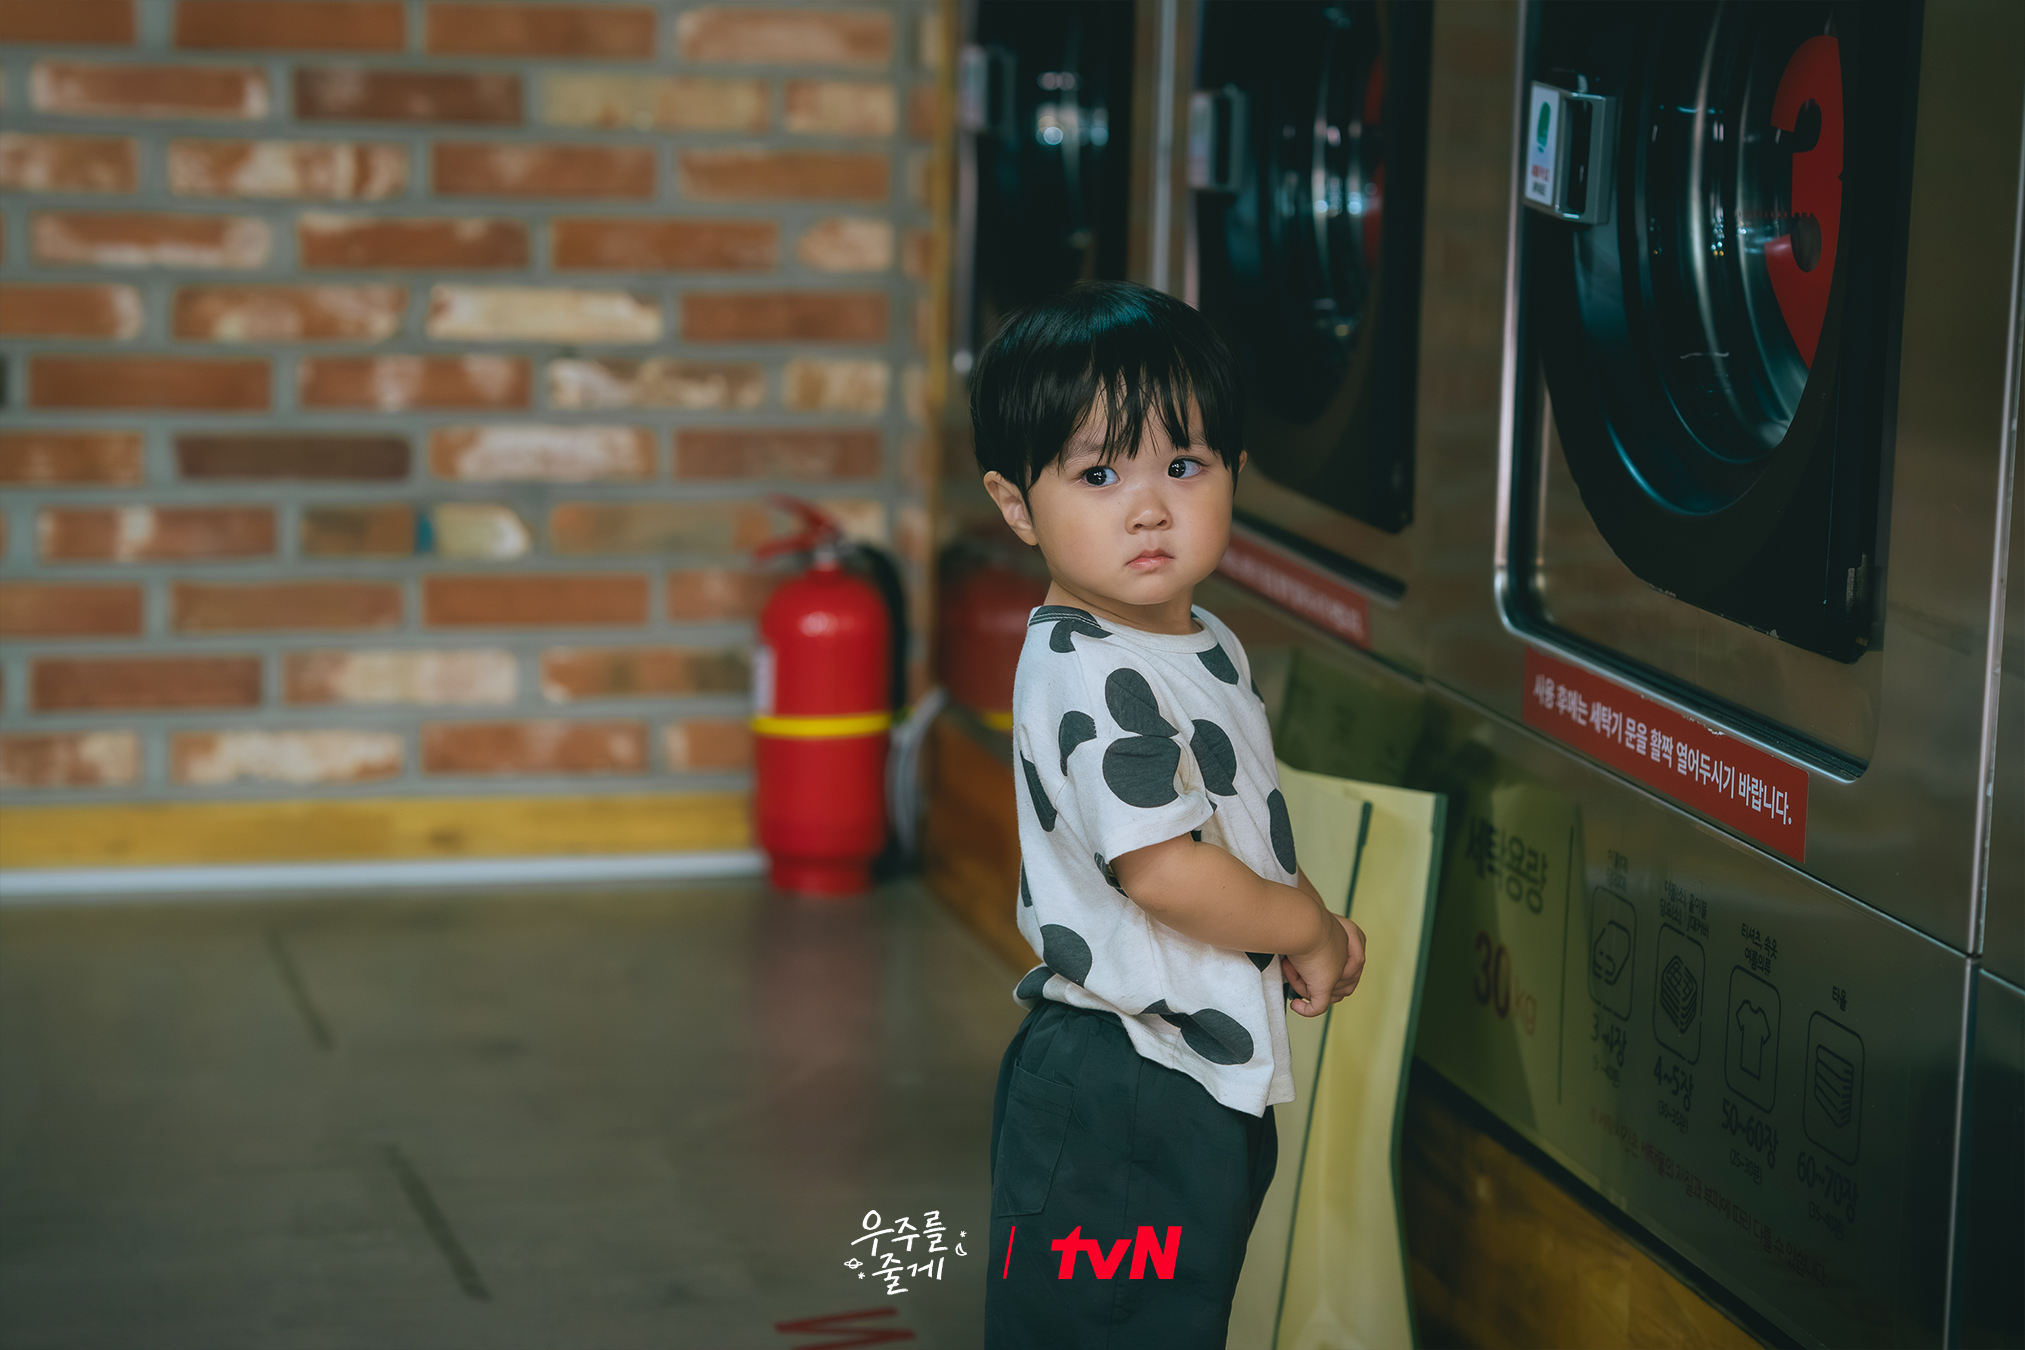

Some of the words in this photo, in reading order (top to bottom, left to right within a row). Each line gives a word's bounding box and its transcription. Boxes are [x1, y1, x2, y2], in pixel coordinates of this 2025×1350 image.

[1533, 674, 1555, 710] 사용
[1556, 684, 1588, 726] 후에는
[1589, 701, 1622, 744] 세탁기
[1625, 717, 1648, 755] 문을
[1650, 728, 1673, 768] 활짝
[1676, 741, 1735, 799] 열어두시기
[1738, 772, 1792, 825] 바랍니다.
[1764, 936, 1778, 960] 속옷
[1653, 1056, 1694, 1112] 4~5장
[1721, 1098, 1779, 1169] 50~60장
[1797, 1151, 1860, 1223] 60~70장
[1732, 1204, 1752, 1235] 따라
[1753, 1218, 1772, 1255] 다를
[1773, 1235, 1784, 1259] 수
[1785, 1242, 1828, 1288] 있습니다.
